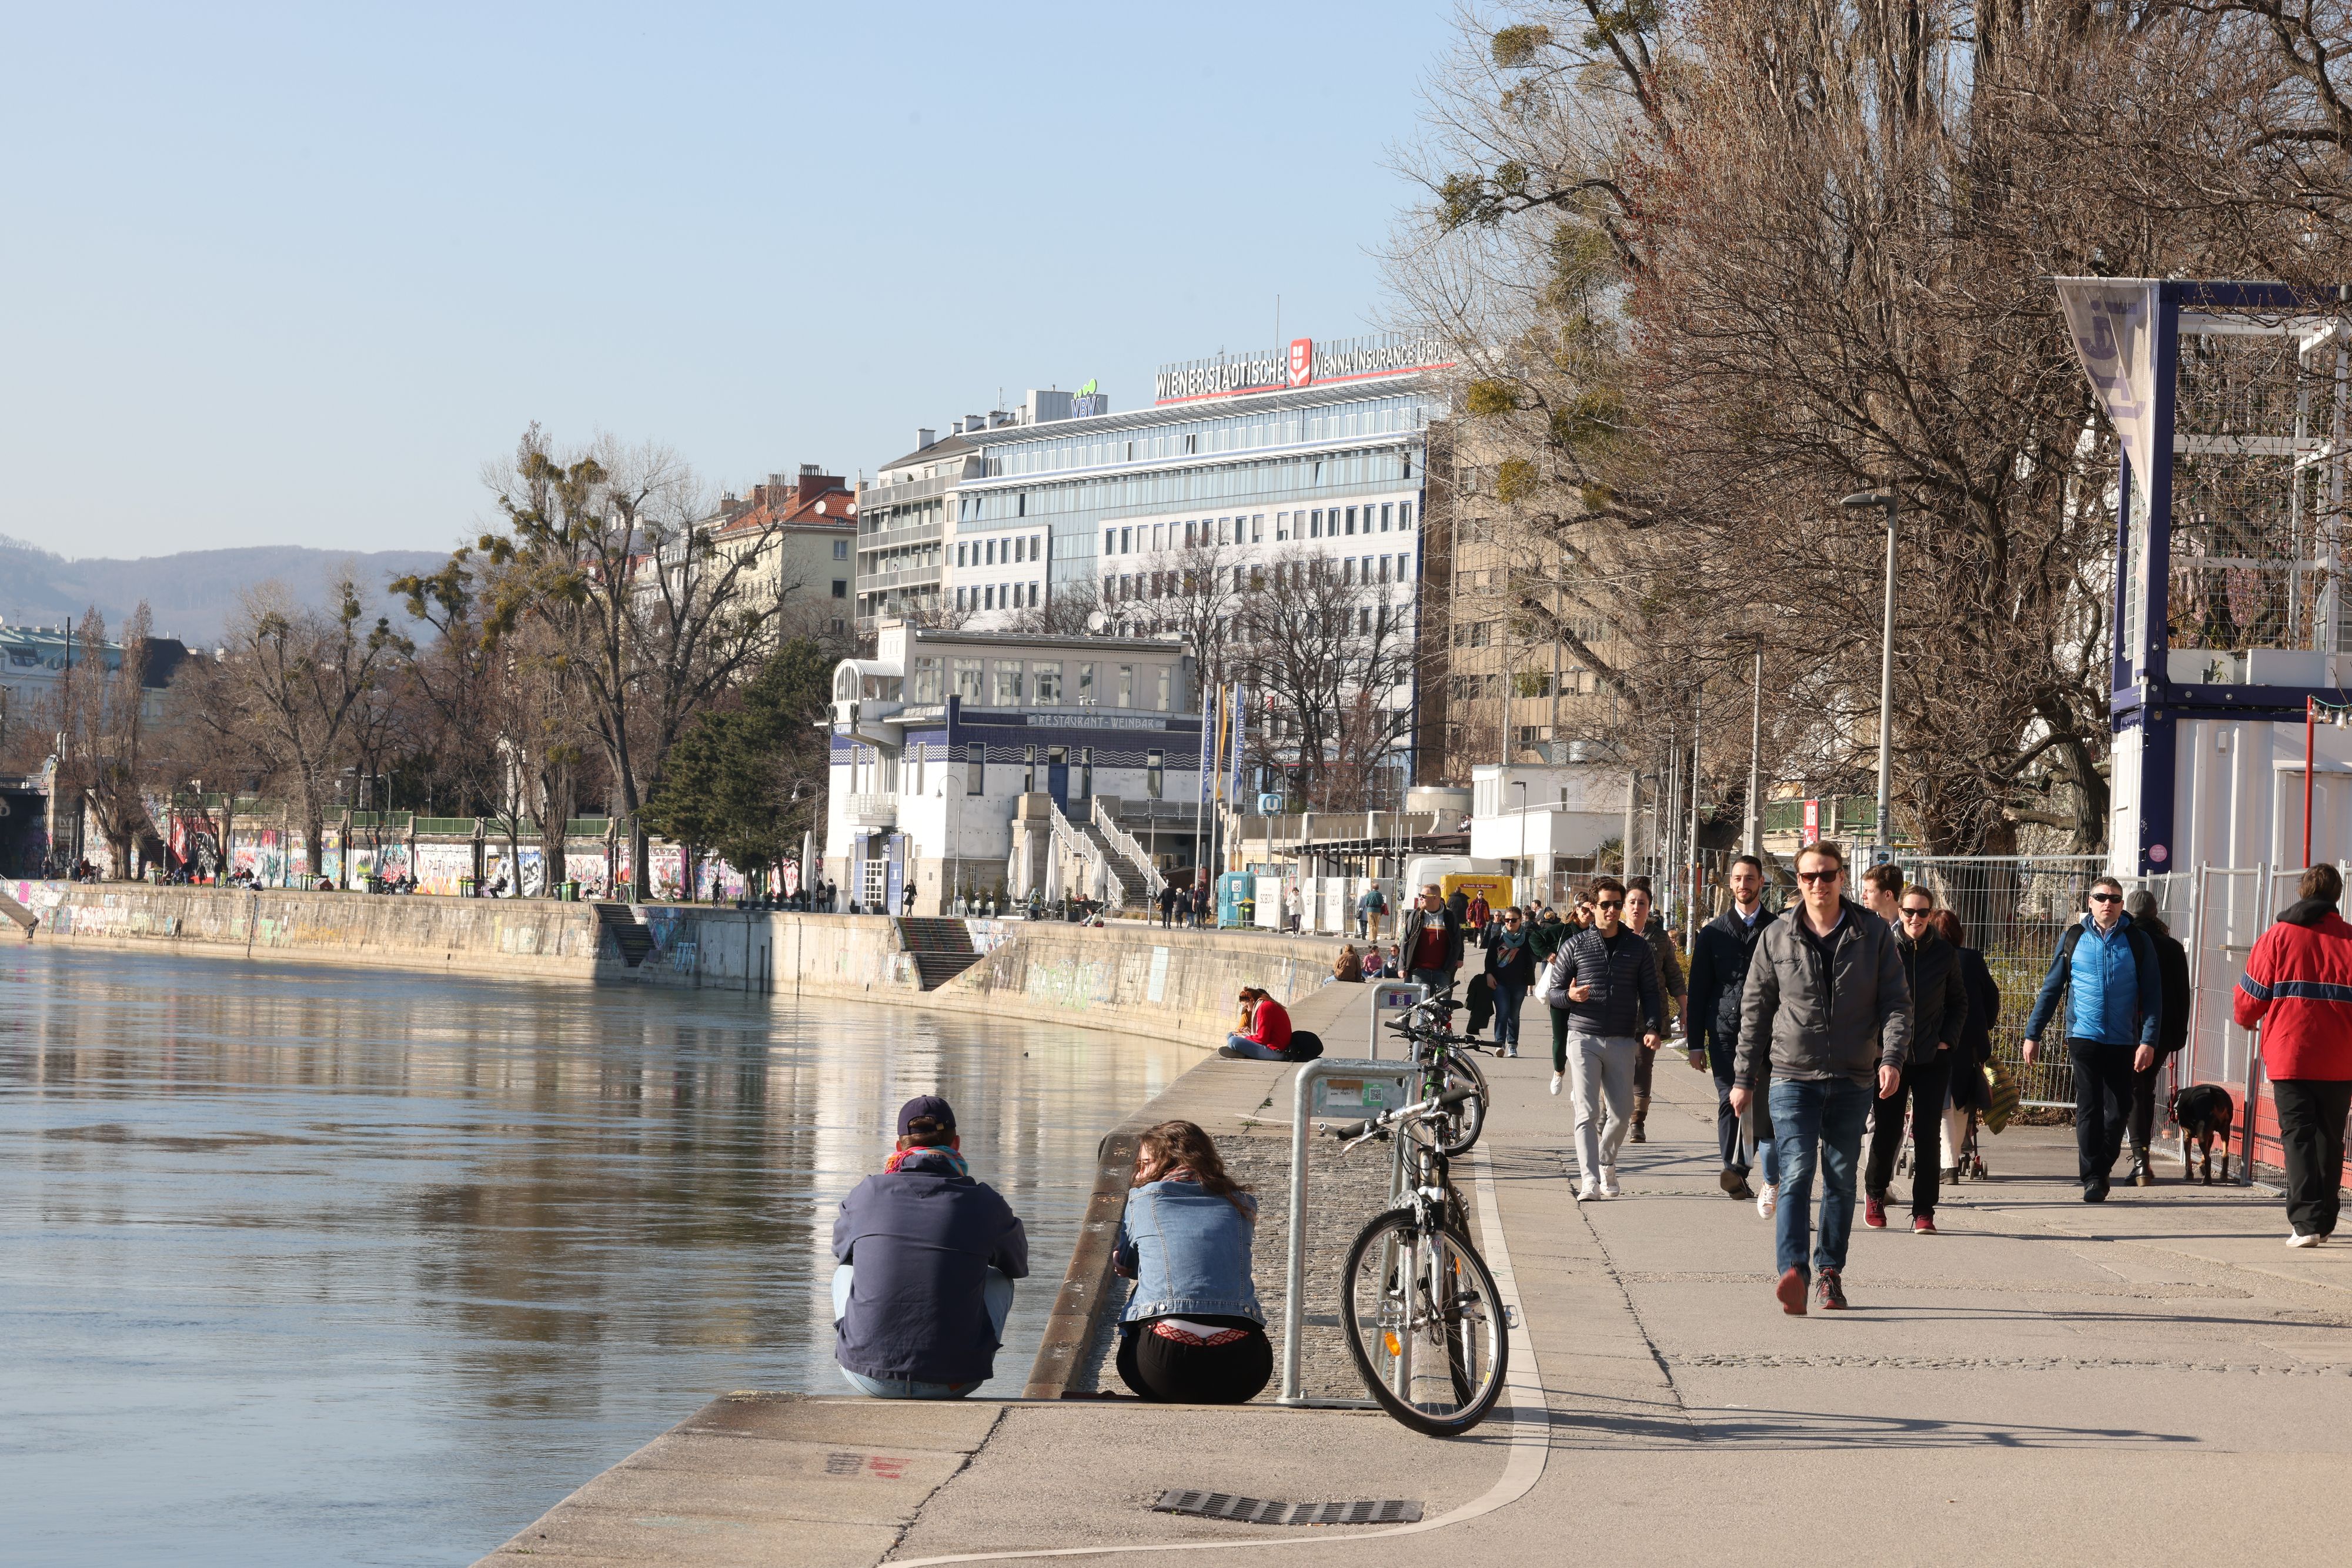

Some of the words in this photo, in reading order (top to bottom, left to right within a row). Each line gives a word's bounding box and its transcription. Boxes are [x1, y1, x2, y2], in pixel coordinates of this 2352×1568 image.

[1314, 352, 1352, 375] VIENNA
[1355, 345, 1415, 370] INSURANCE
[1157, 368, 1205, 397] WIENER
[1207, 357, 1286, 390] STÄDTISCHE
[1071, 396, 1097, 419] VBV
[1039, 715, 1104, 727] RESTAURANT
[1111, 717, 1154, 728] WEINBAR
[1266, 798, 1278, 810] U
